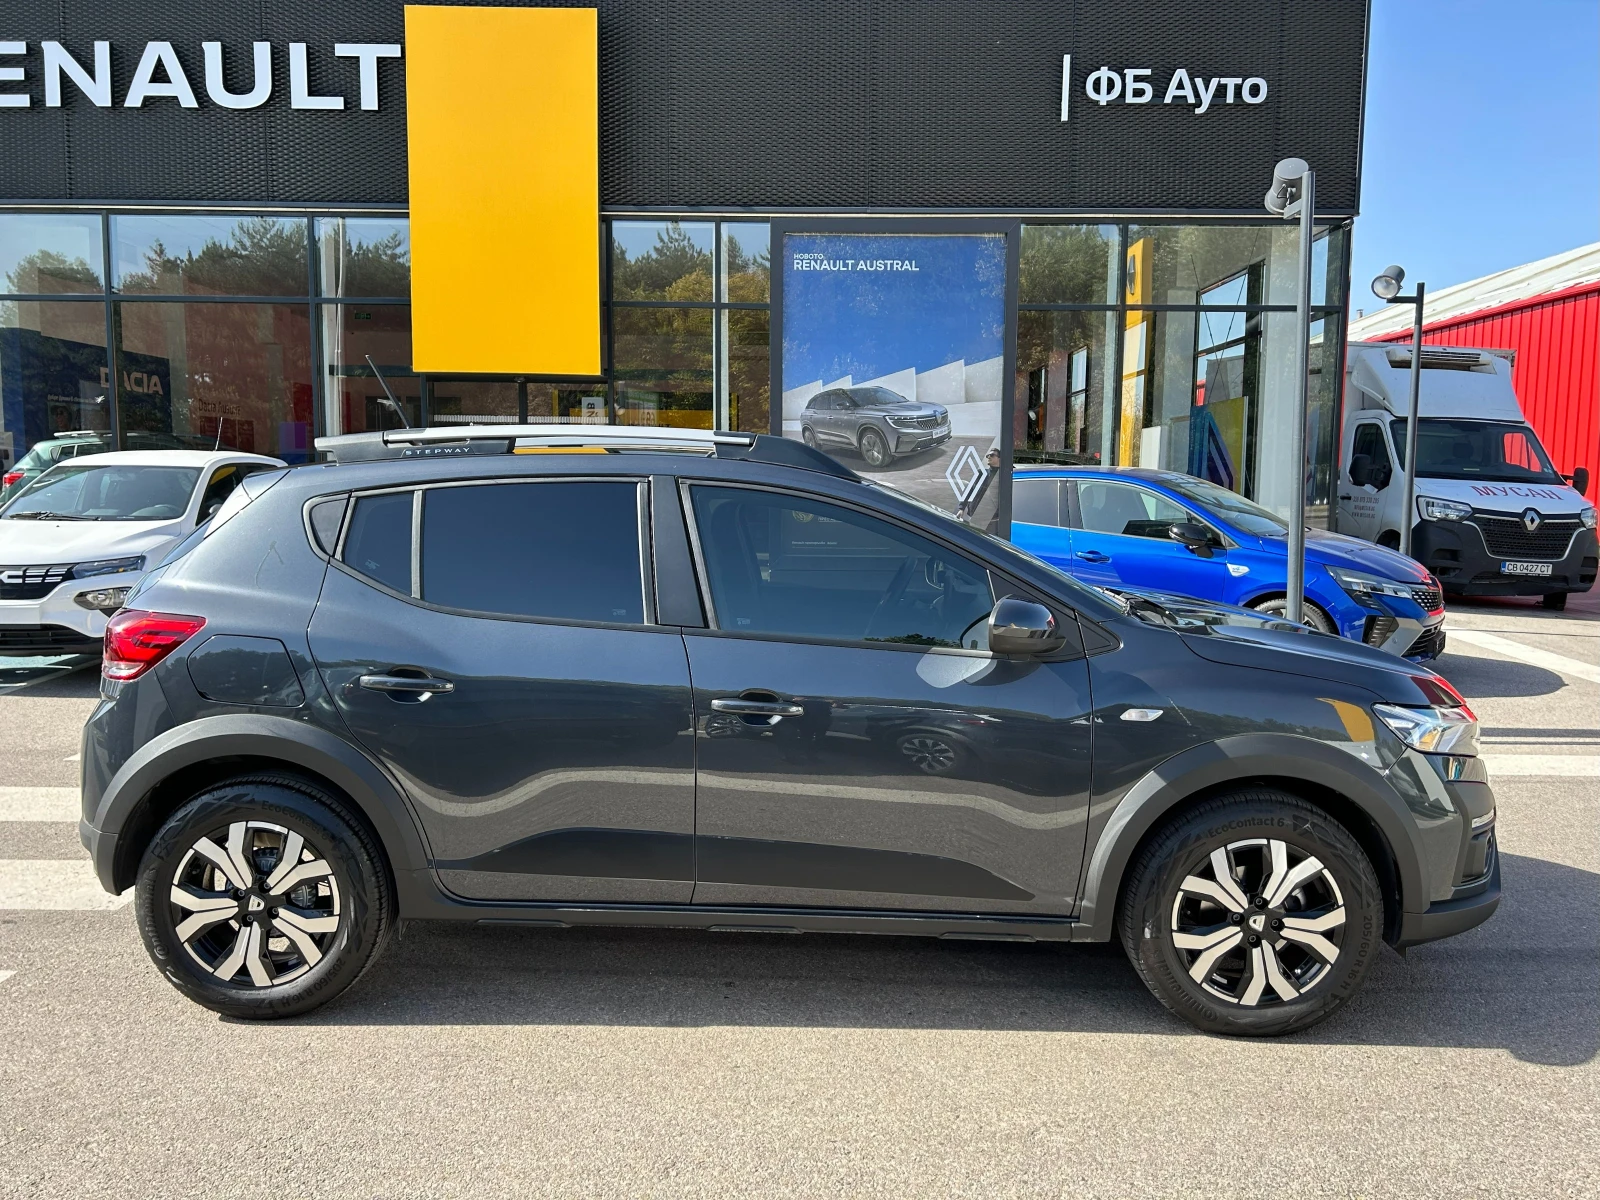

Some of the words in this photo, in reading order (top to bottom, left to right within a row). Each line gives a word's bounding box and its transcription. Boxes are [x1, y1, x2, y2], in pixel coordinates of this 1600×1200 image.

[1085, 66, 1153, 105] ФБ
[1164, 68, 1268, 114] Ауто
[793, 260, 855, 271] RENAULT
[857, 260, 920, 271] AUSTRAL
[405, 447, 470, 456] STEPWAY
[1507, 563, 1517, 571] CB
[1519, 564, 1539, 573] 0427
[1540, 564, 1551, 573] CT
[1208, 817, 1275, 838] EcoContact
[1277, 818, 1285, 828] 6
[1358, 915, 1373, 958] 205/60
[314, 958, 346, 991] 205/60
[1347, 968, 1360, 980] 16
[1340, 981, 1350, 990] H
